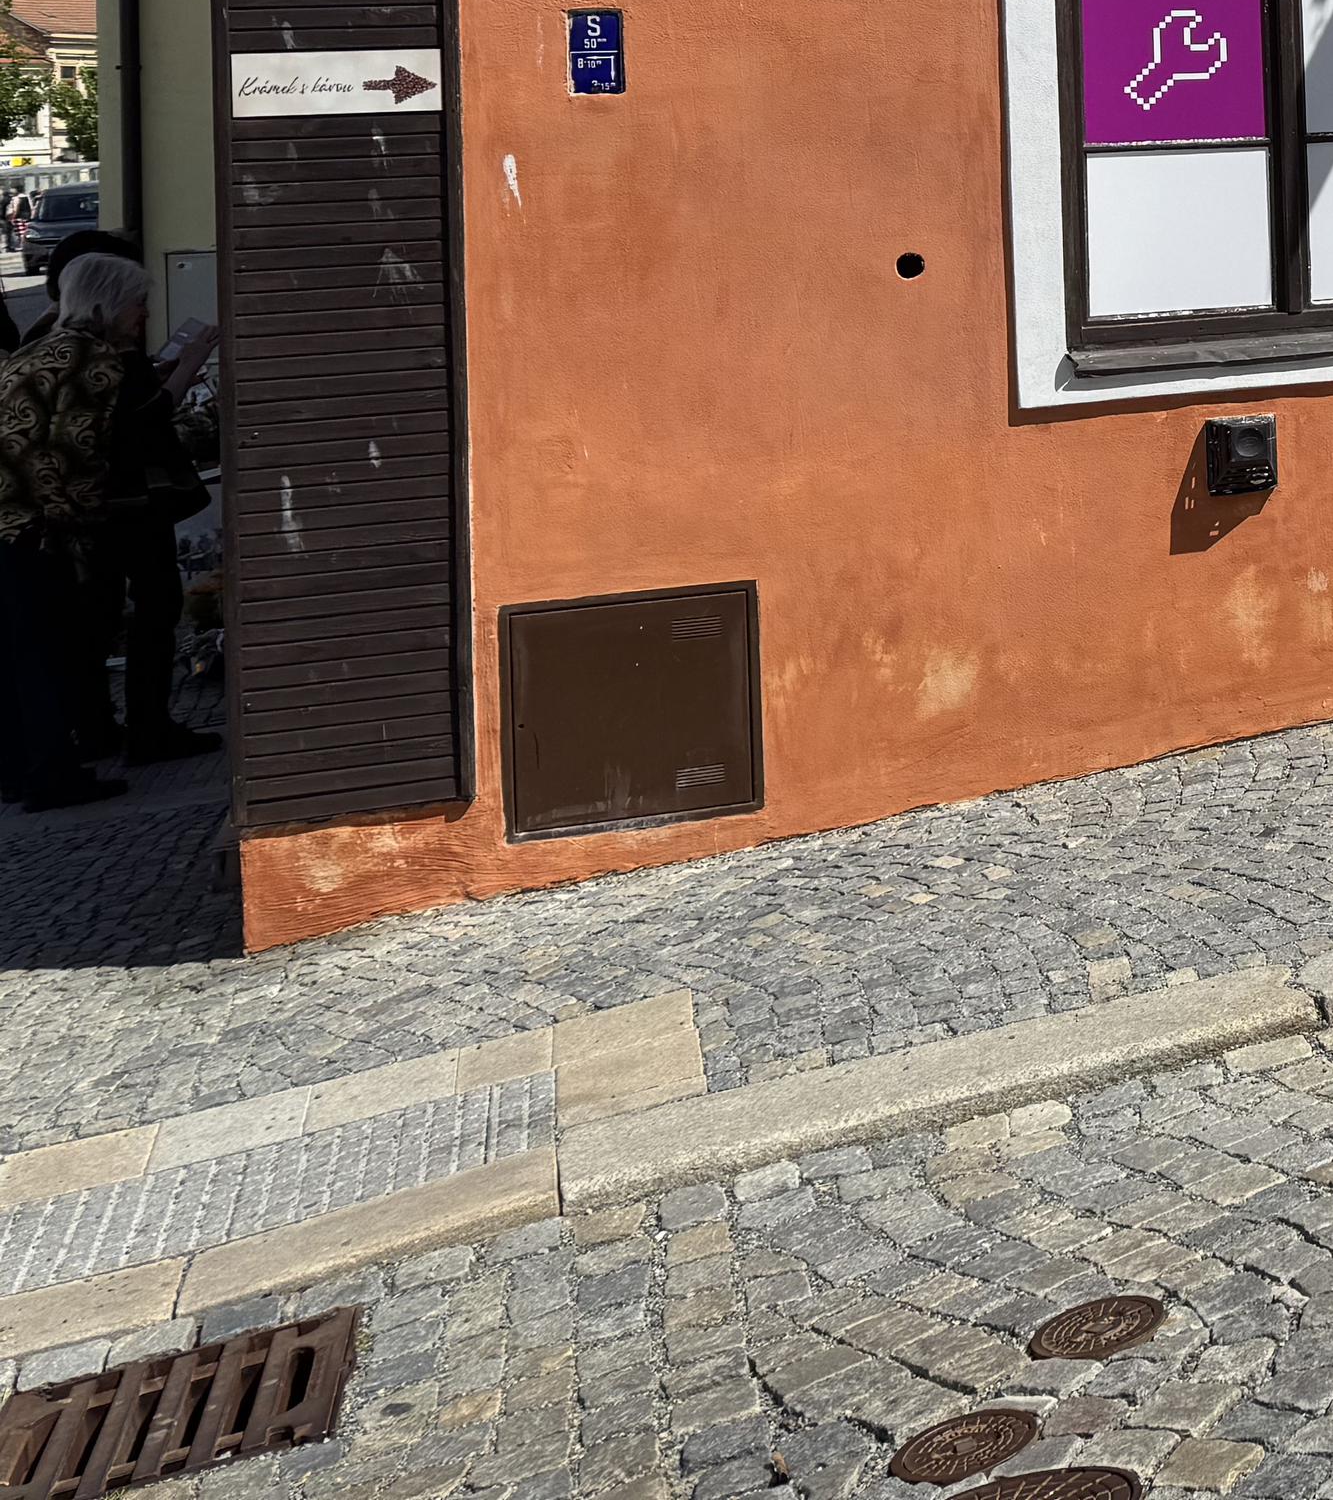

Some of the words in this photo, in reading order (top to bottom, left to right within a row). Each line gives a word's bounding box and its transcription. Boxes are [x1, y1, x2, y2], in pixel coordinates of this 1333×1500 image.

[586, 15, 601, 37] S
[238, 76, 299, 98] Krámek
[299, 83, 308, 95] s
[311, 76, 354, 94] kávou
